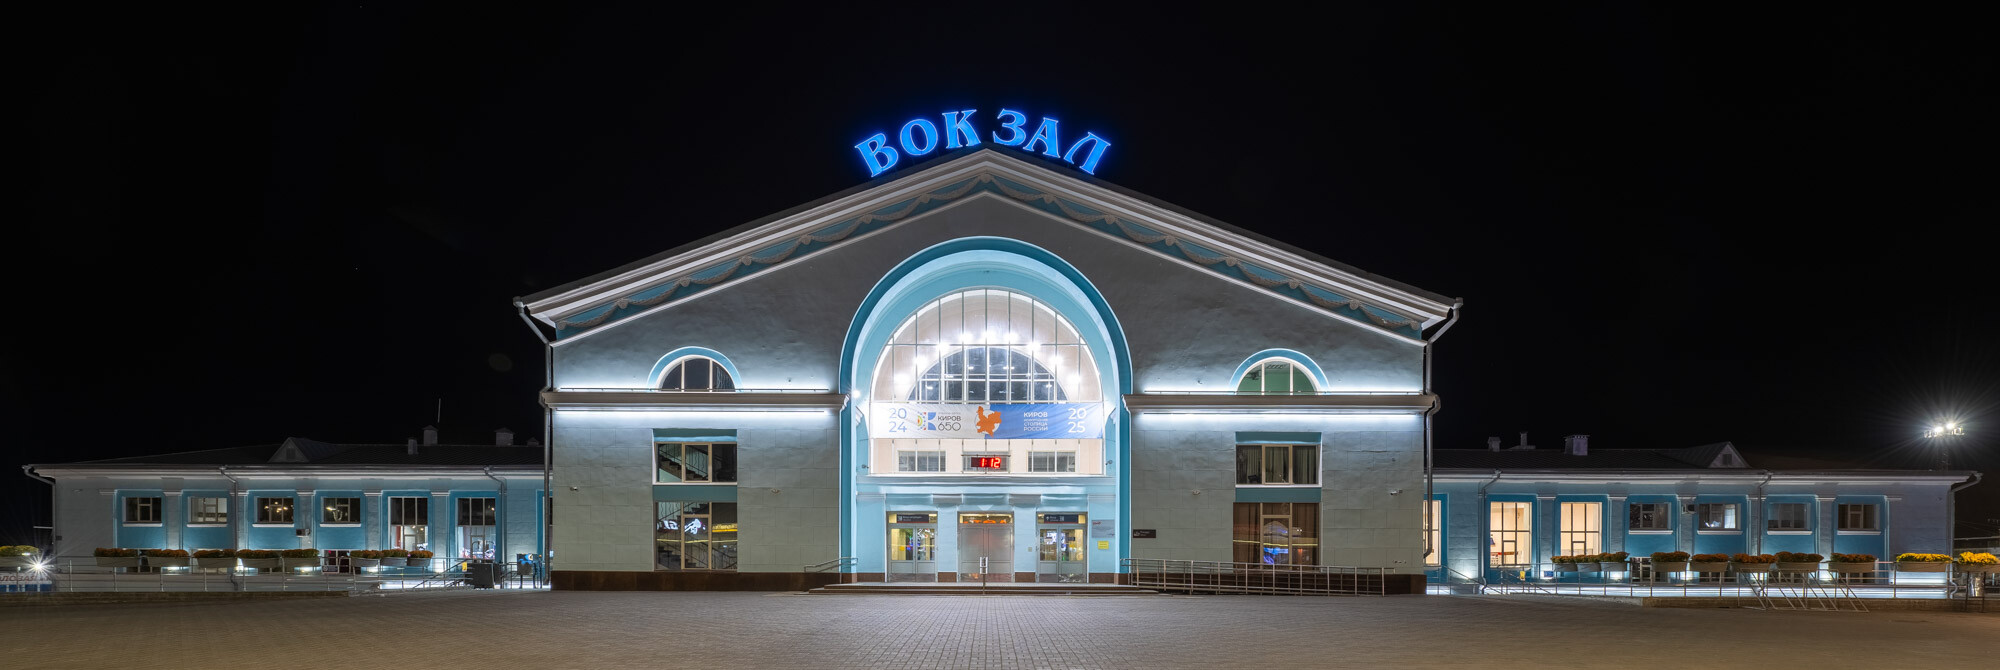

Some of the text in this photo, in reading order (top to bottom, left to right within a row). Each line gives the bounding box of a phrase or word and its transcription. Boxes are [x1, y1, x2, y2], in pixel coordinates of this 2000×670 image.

[854, 108, 1112, 178] ВОКЗАЛ
[889, 407, 907, 419] 20
[1068, 408, 1087, 420] 20
[889, 420, 907, 433] 24
[938, 421, 961, 431] 650
[1068, 420, 1086, 433] 25
